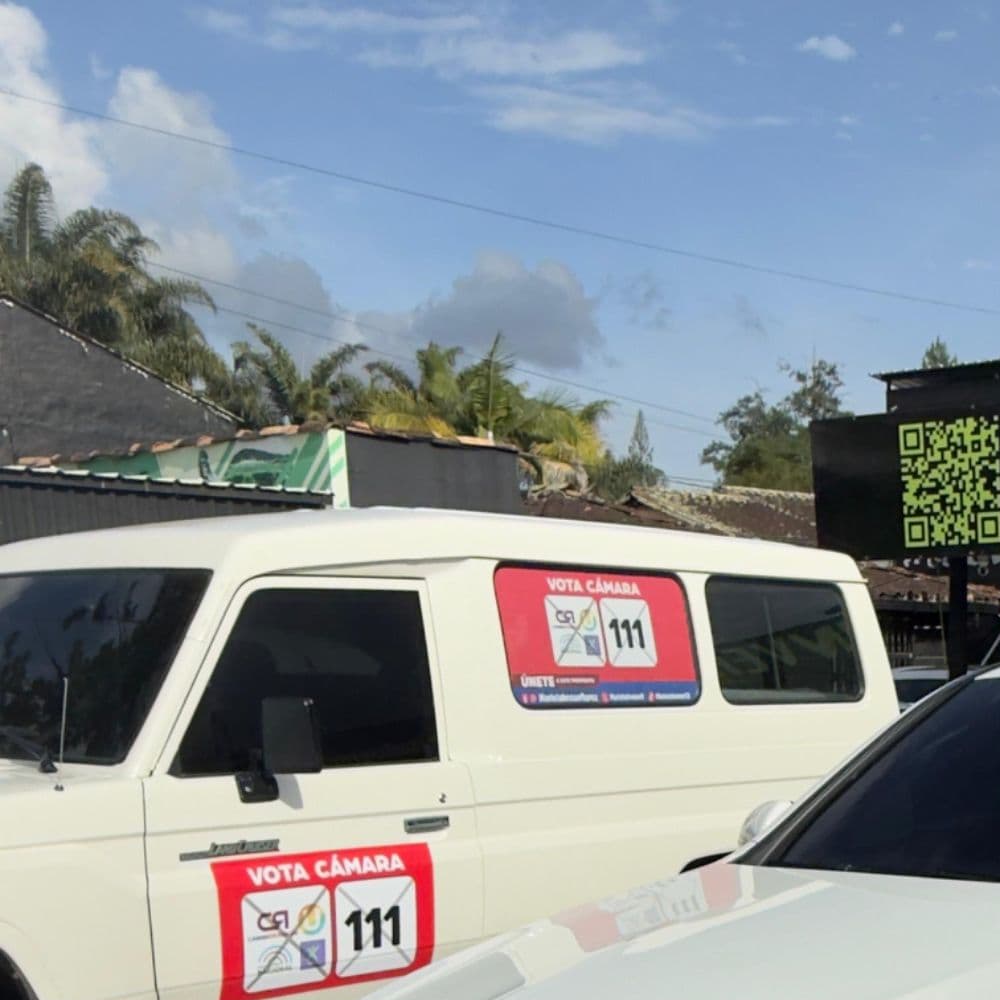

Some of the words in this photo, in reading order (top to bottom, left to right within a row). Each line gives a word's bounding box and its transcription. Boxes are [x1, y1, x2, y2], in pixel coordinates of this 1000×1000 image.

[546, 577, 584, 593] VOTA
[608, 618, 646, 649] 111
[246, 863, 311, 887] VOTA
[313, 853, 406, 879] CÁMARA
[344, 904, 401, 952] 111
